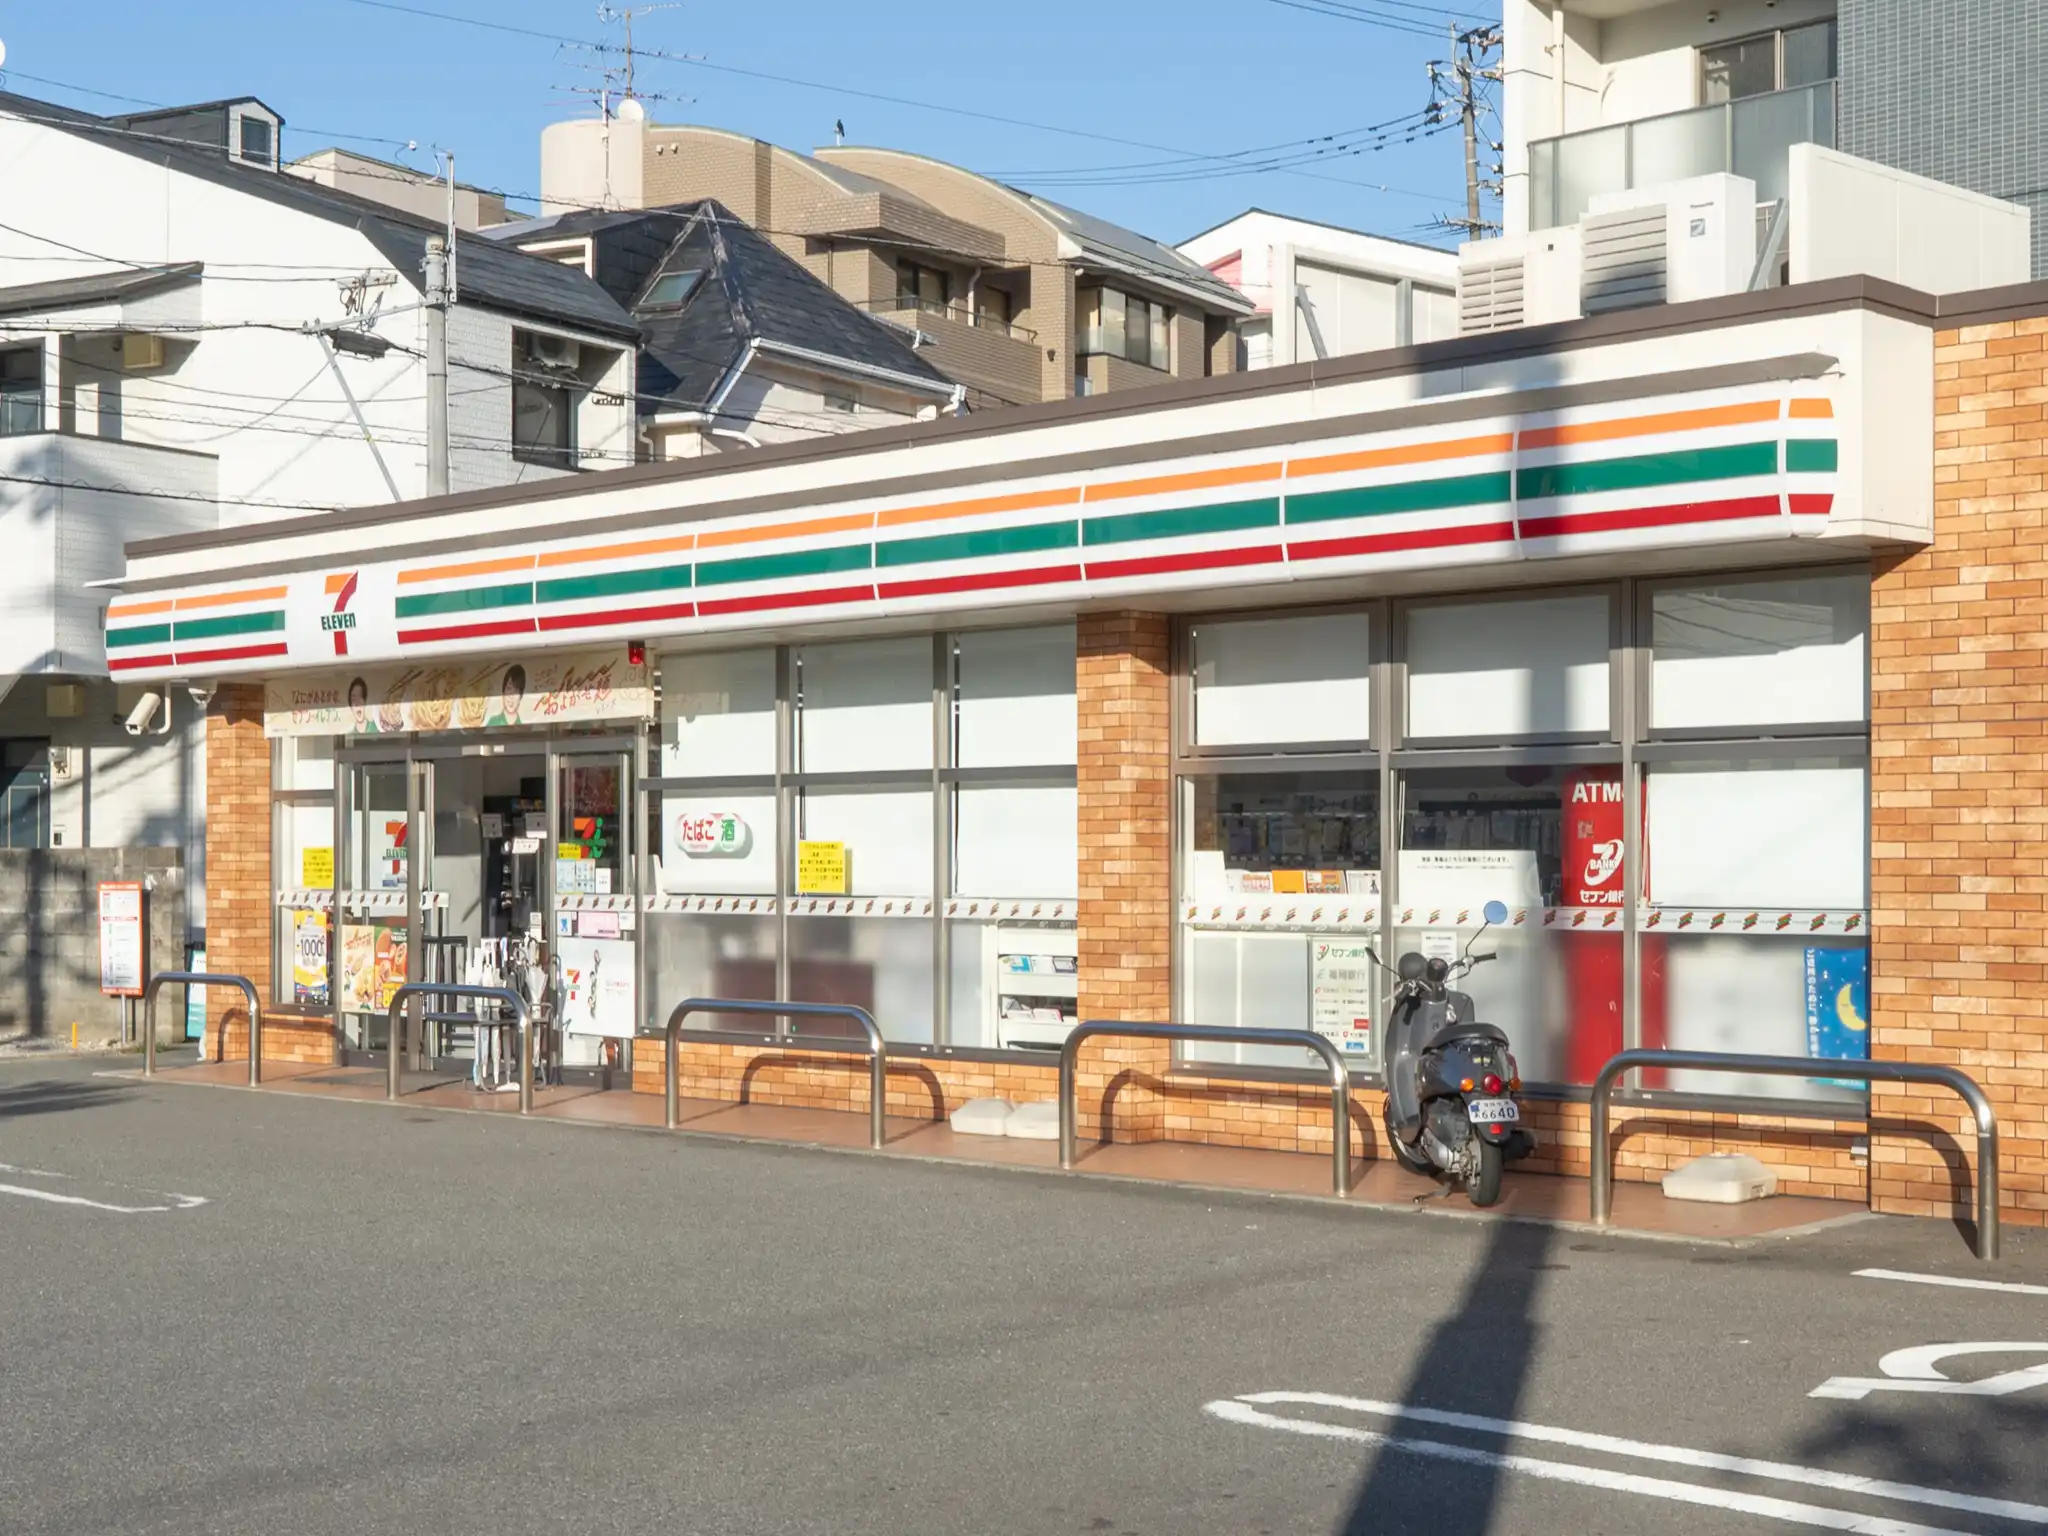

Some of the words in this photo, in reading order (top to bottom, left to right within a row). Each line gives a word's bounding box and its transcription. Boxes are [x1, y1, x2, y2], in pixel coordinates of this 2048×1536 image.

[324, 570, 358, 656] 7
[682, 819, 715, 842] たばこ
[720, 819, 736, 842] 酒
[1481, 1107, 1515, 1119] 6640
